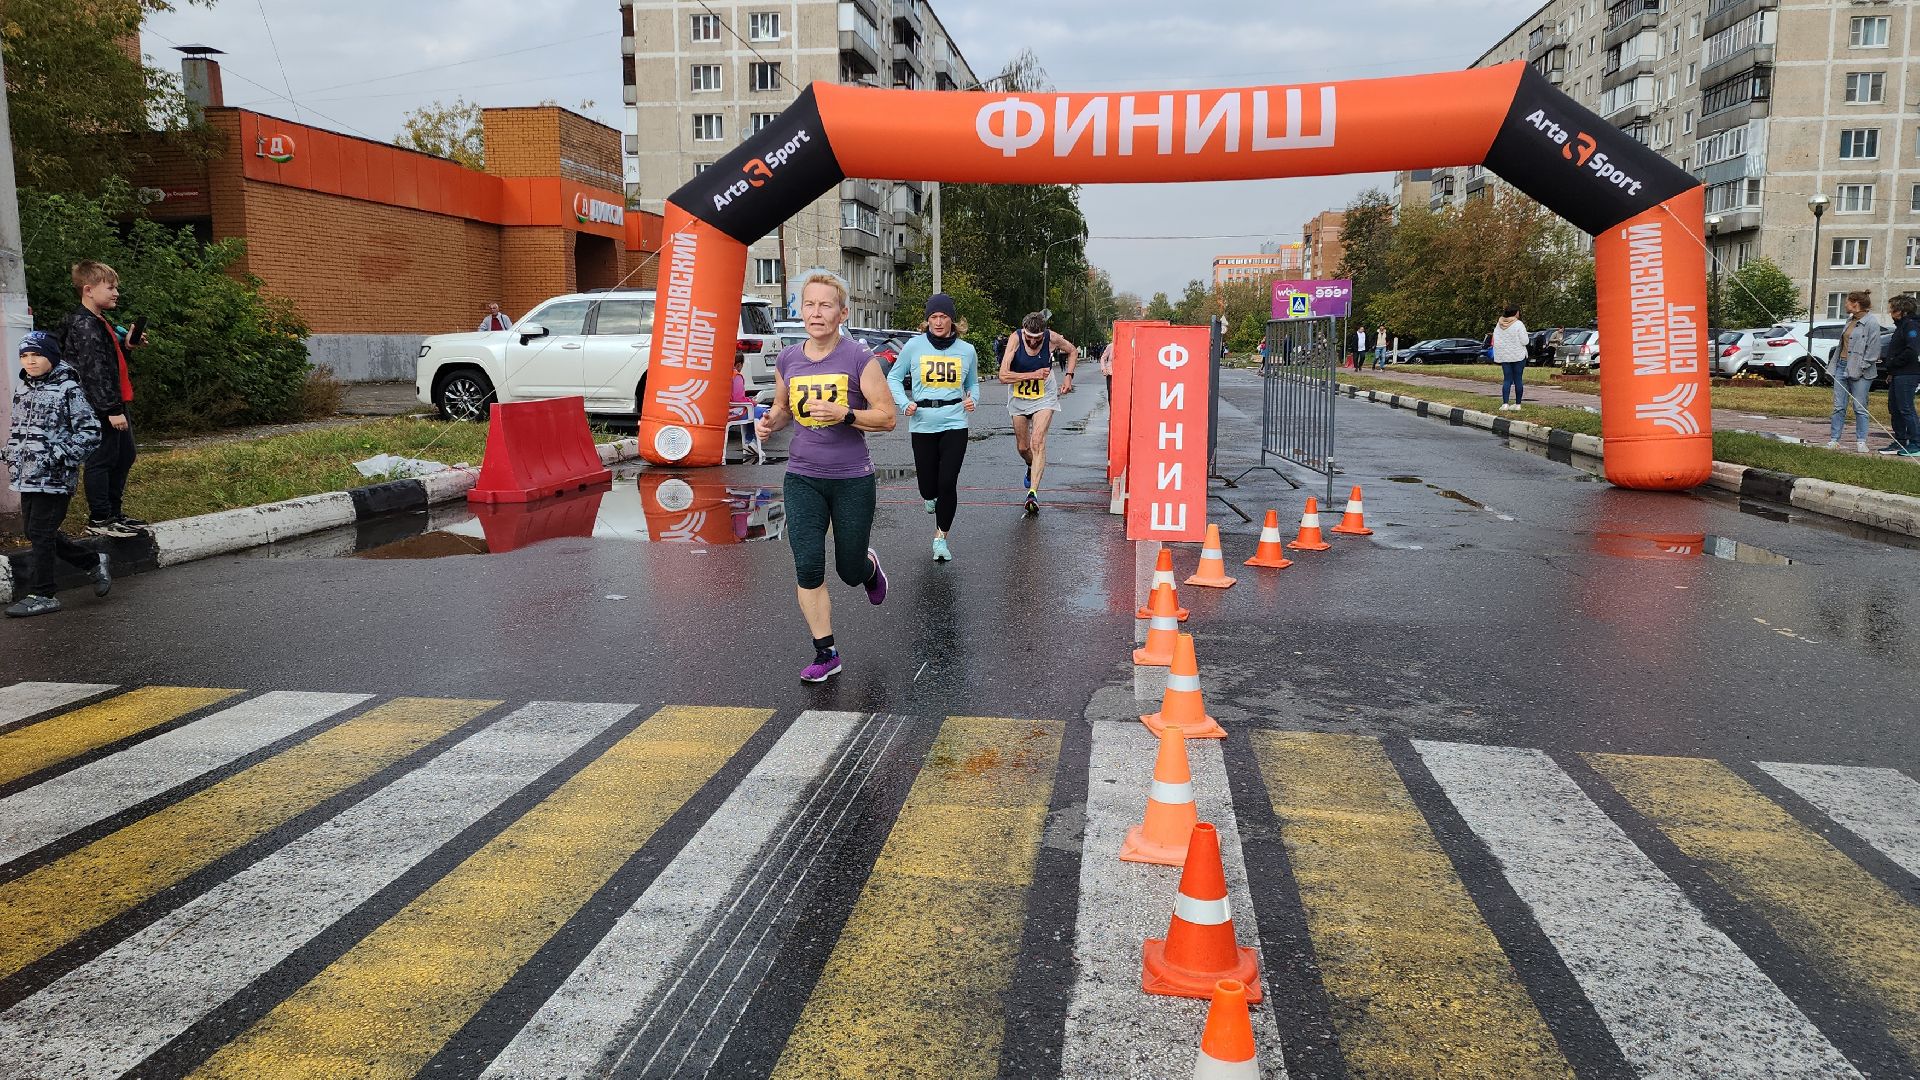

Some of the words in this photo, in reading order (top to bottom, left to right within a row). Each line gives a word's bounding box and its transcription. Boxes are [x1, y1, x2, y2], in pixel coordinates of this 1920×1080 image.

[975, 86, 1336, 158] ФИНИШ
[1525, 109, 1569, 145] Arta
[1588, 152, 1642, 196] Sport
[713, 179, 750, 212] Arta
[765, 129, 811, 169] Sport
[660, 232, 698, 368] МОСКОВСКИЙ
[1621, 222, 1667, 376] МОСКОВСКИЙ
[685, 306, 718, 371] СПОРТ
[925, 360, 957, 383] 296
[1667, 302, 1698, 374] СПОРТ
[1017, 379, 1040, 396] 224
[1150, 342, 1189, 531] ФИНИШ
